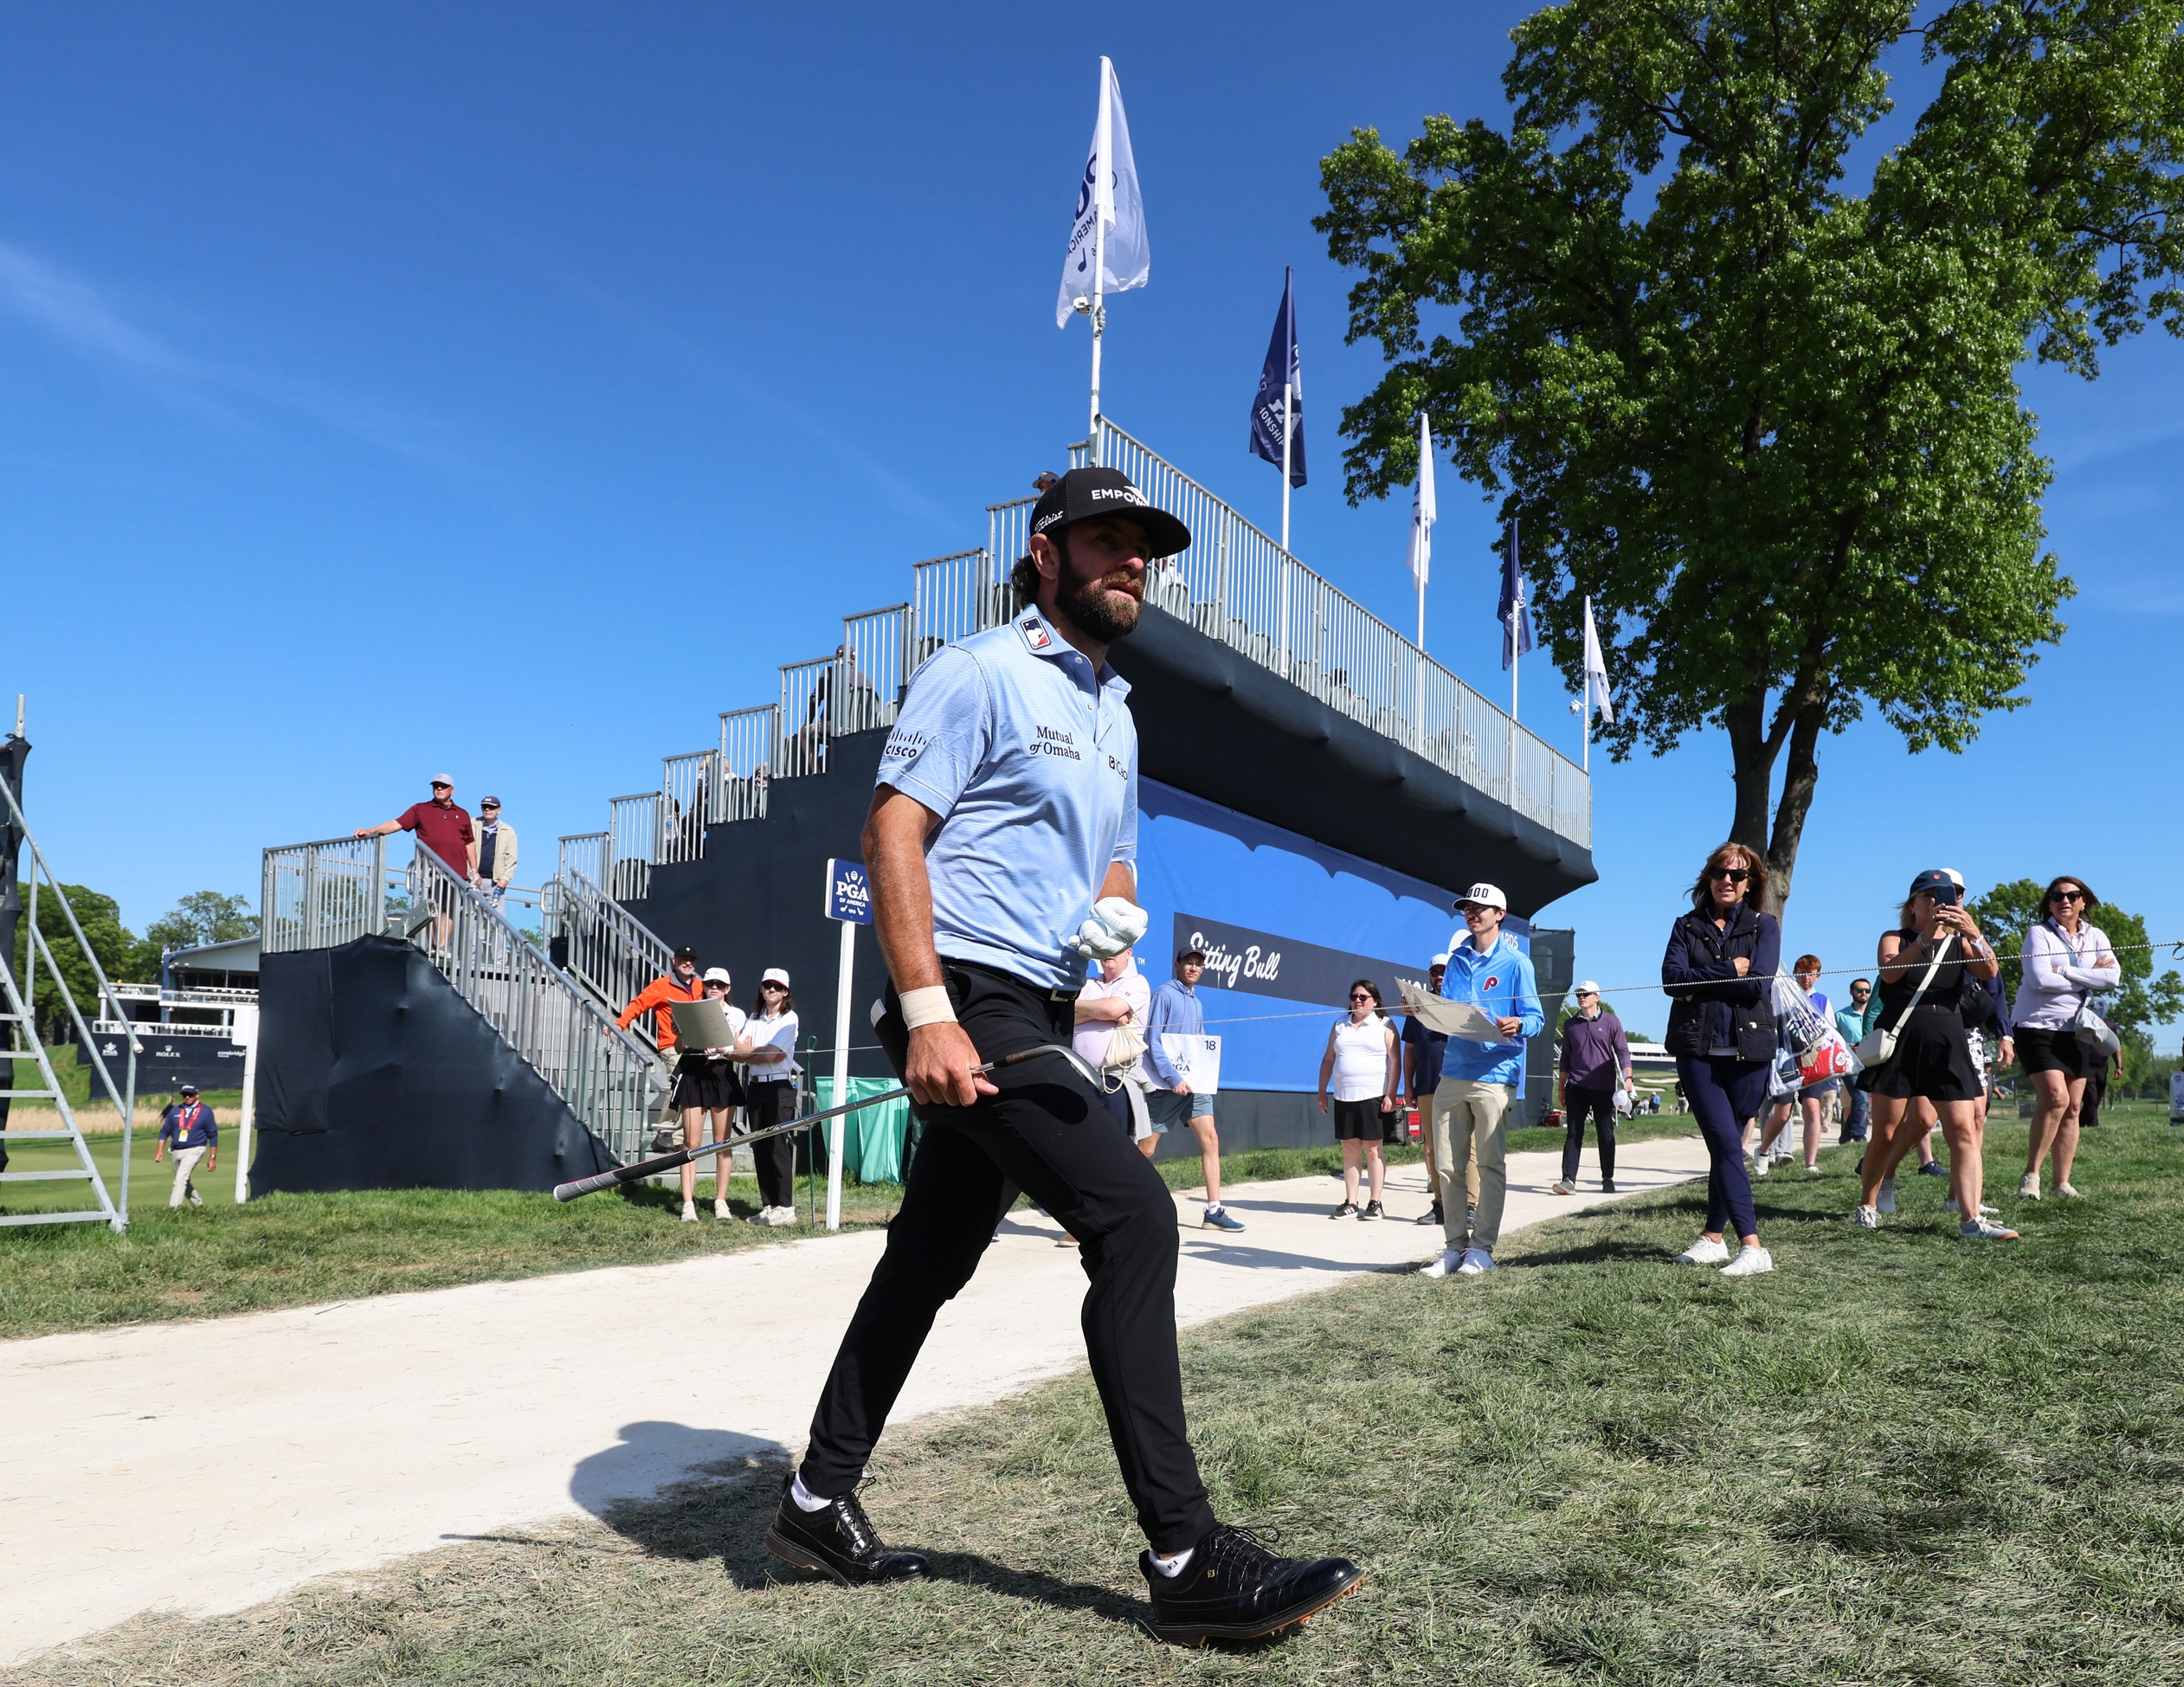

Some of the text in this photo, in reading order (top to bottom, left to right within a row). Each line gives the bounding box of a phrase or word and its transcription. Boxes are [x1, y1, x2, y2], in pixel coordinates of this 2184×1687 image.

[1036, 725, 1073, 744] Mutual
[1029, 742, 1081, 761] of Omaha
[835, 881, 870, 902] PGA
[847, 898, 866, 908] AMERICA
[1243, 945, 1280, 981] Bull
[1205, 1040, 1216, 1051] 18
